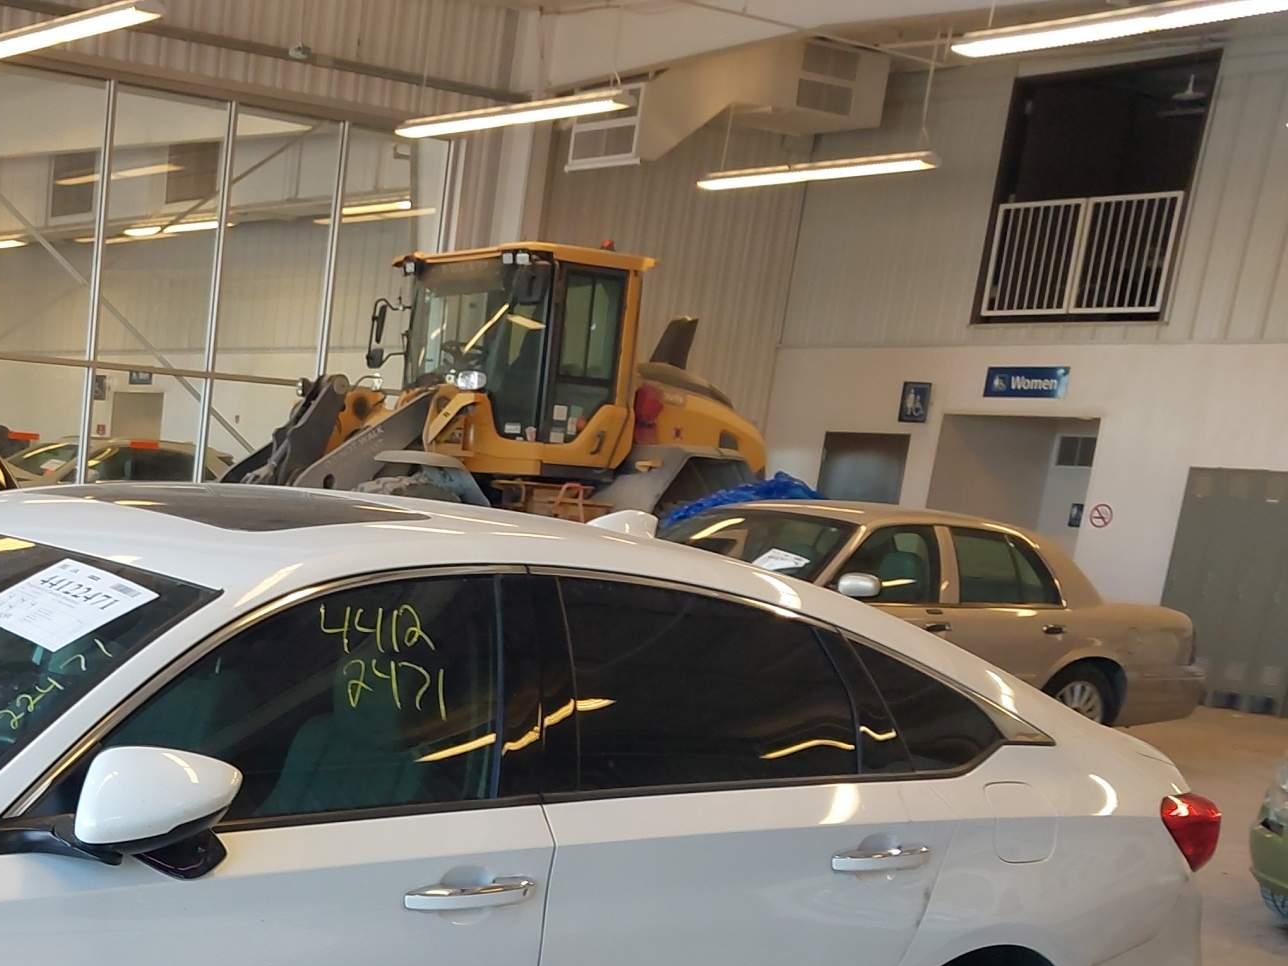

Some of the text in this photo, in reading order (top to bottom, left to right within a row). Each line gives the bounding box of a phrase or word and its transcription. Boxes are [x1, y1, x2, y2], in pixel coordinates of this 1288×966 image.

[1011, 375, 1058, 391] Women
[39, 575, 120, 610] 44122471
[320, 603, 436, 654] 4412
[343, 659, 447, 721] 2471
